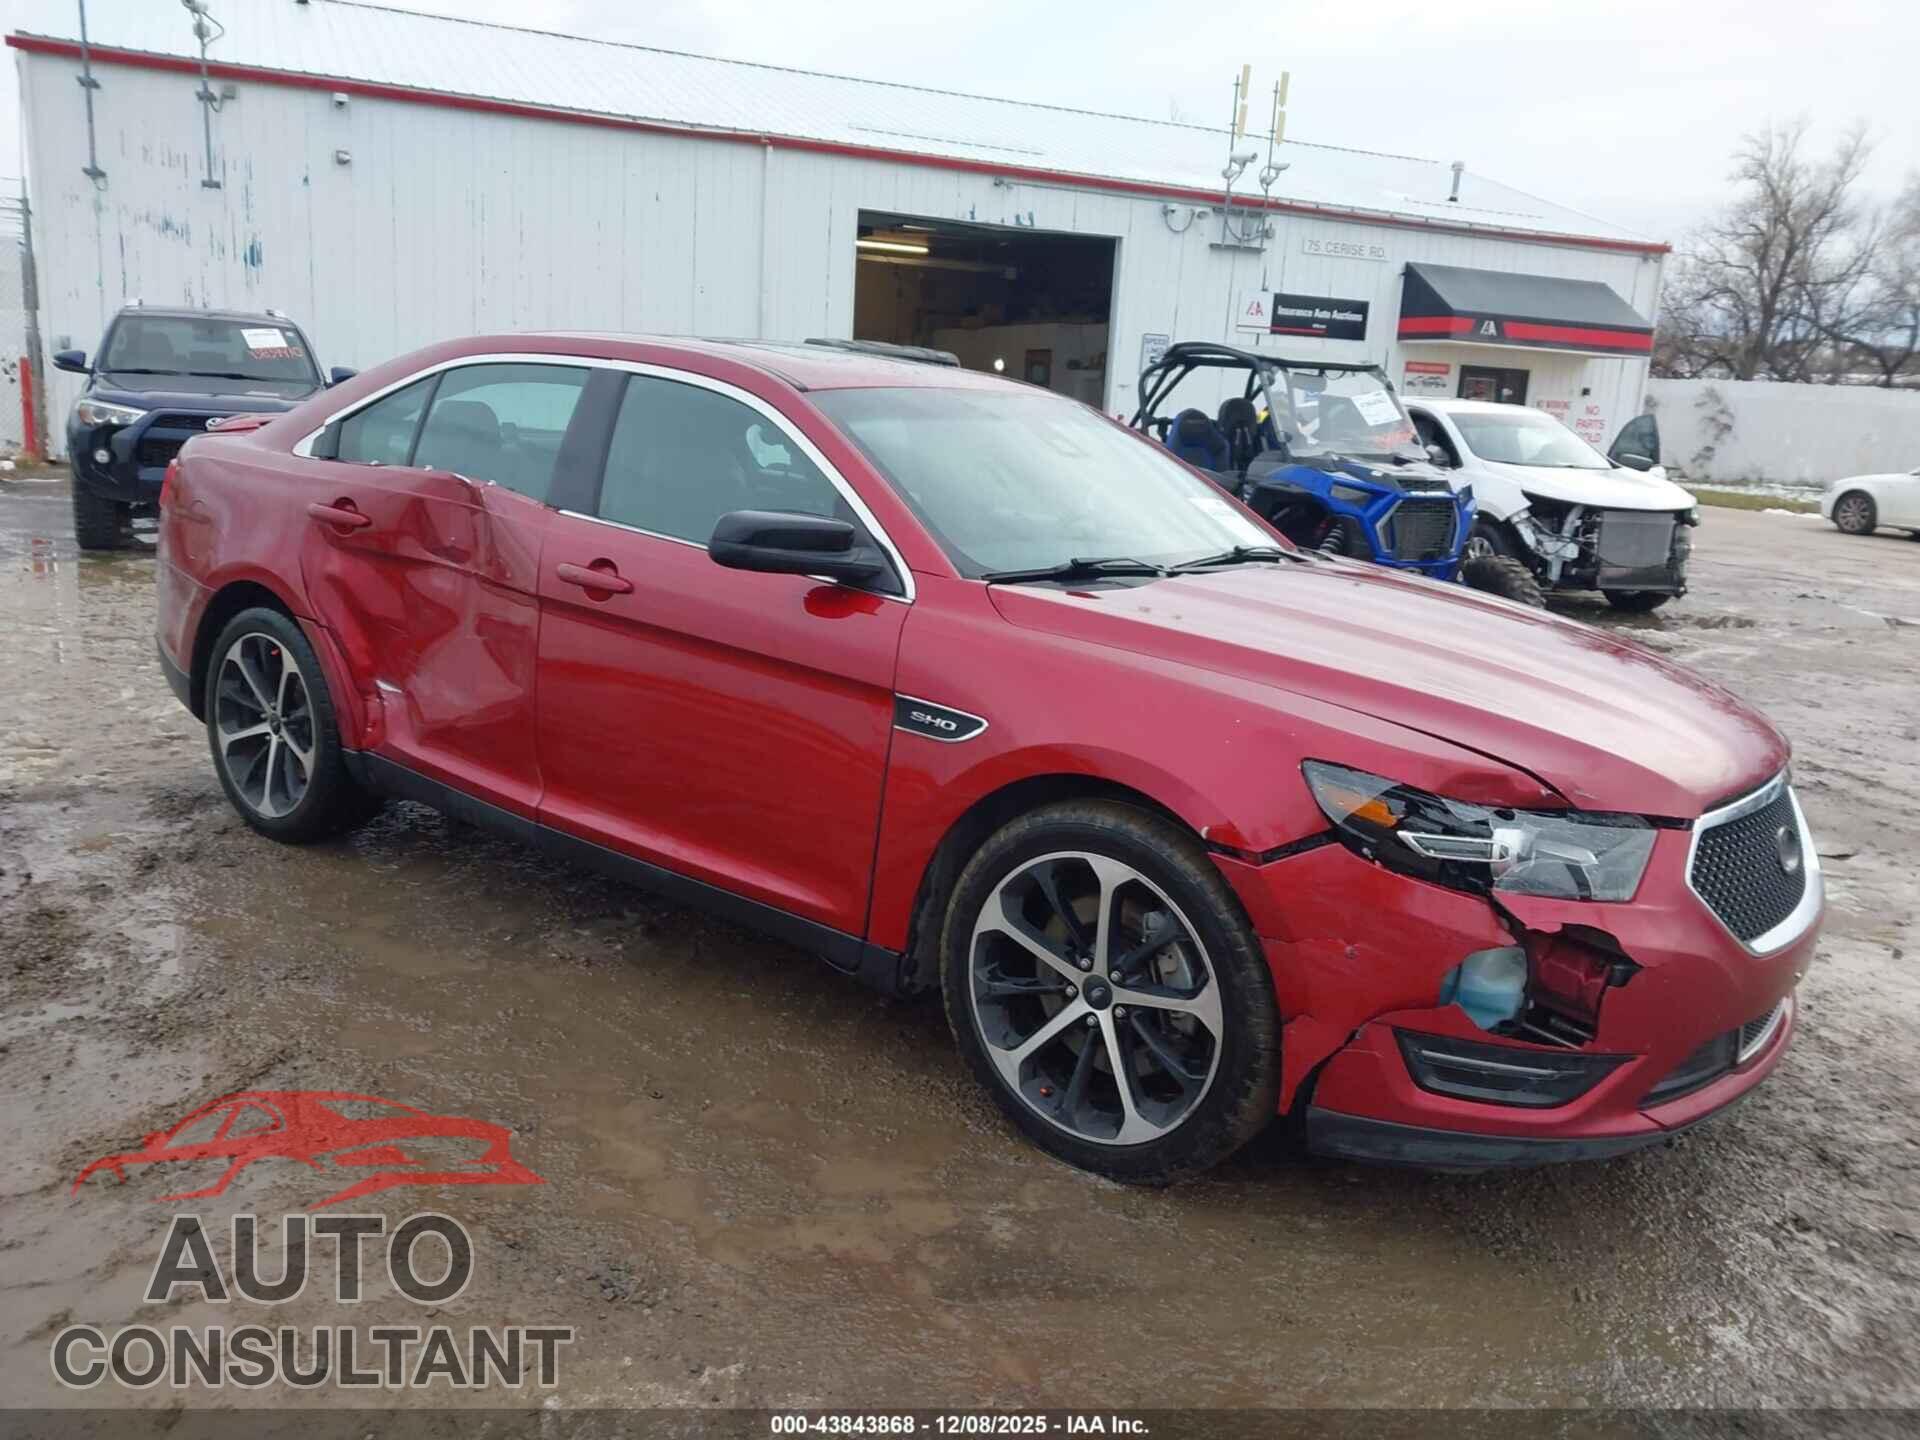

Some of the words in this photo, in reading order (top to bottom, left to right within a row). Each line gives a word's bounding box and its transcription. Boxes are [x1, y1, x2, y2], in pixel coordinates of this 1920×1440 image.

[1326, 241, 1366, 257] CERISE
[1369, 245, 1385, 258] RD
[1277, 305, 1313, 318] Insurance
[1314, 308, 1331, 320] Auto
[910, 711, 957, 731] SHO
